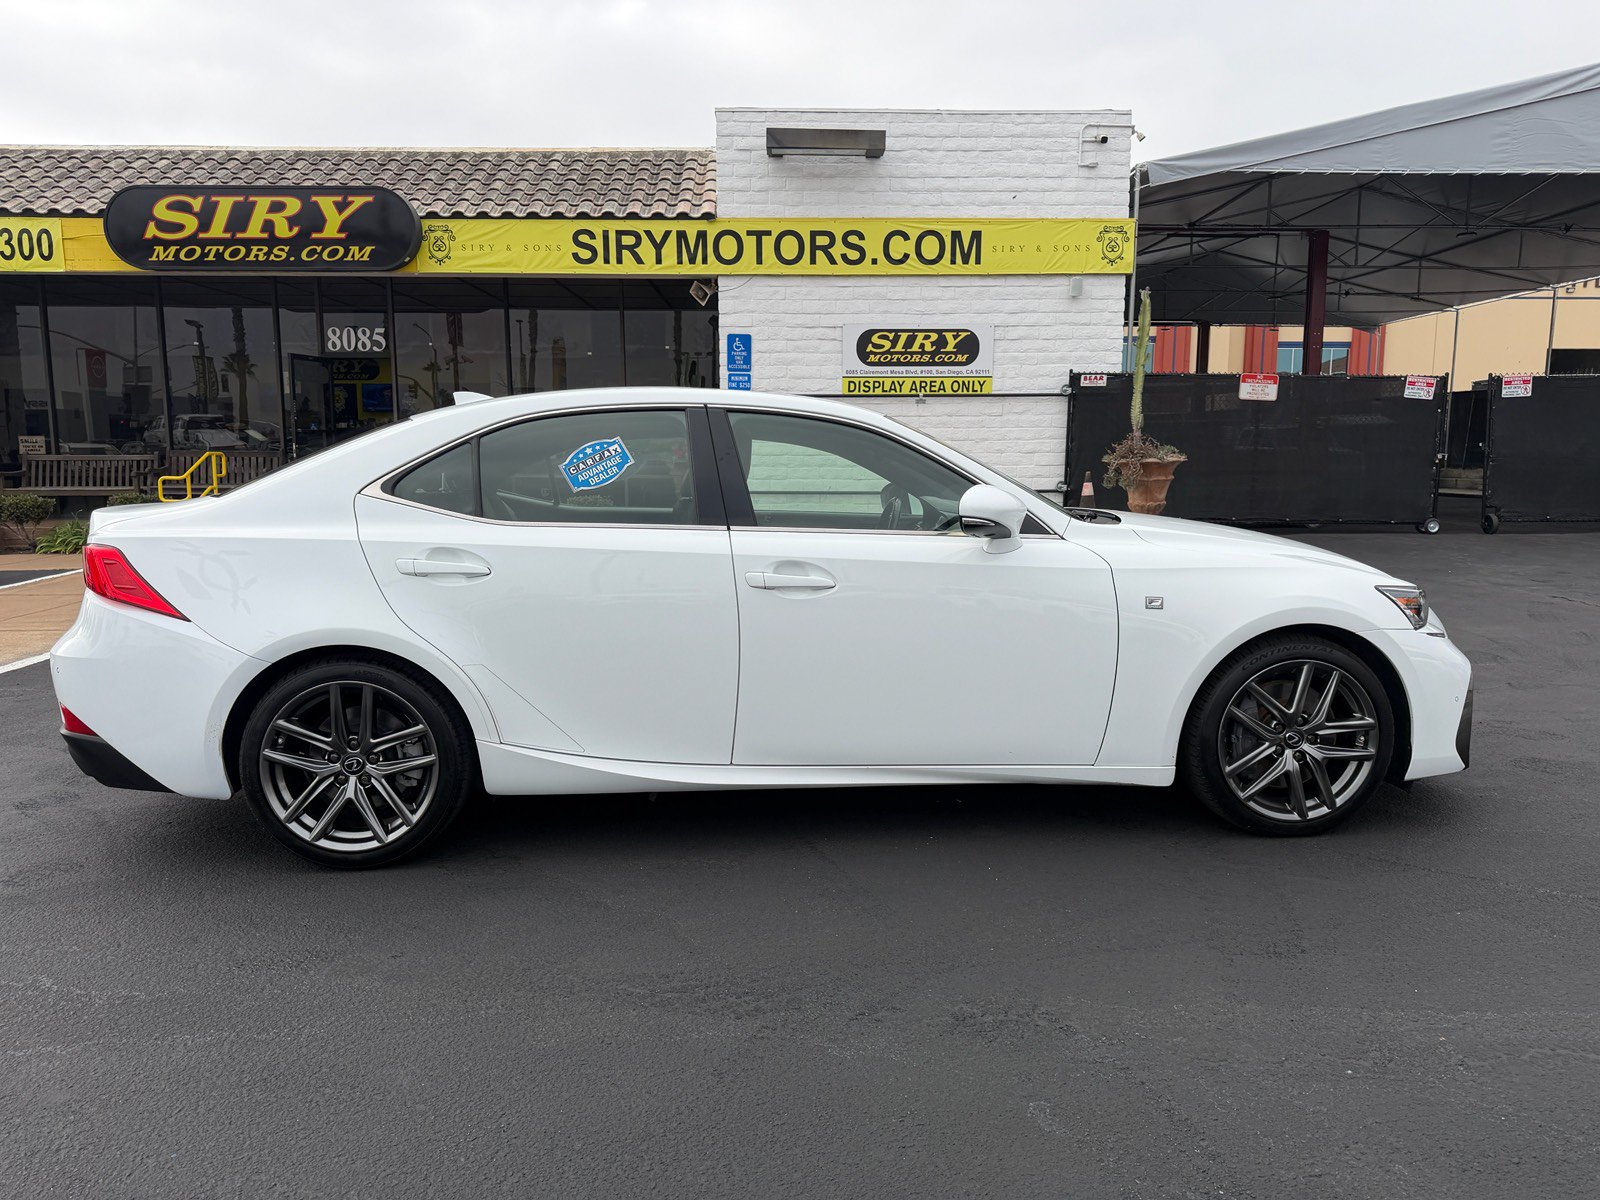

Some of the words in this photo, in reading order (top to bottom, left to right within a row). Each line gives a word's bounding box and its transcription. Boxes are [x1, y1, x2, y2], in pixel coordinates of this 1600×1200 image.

[144, 194, 375, 241] SIRY
[148, 245, 375, 262] MOTORS.COM
[461, 244, 495, 252] SIRY
[505, 244, 512, 252] &
[523, 244, 562, 252] SONS
[571, 228, 982, 266] SIRYMOTORS.COM
[991, 244, 1026, 253] SIRY
[1035, 244, 1042, 253] &
[1052, 244, 1091, 253] SONS
[327, 326, 387, 352] 8085
[865, 331, 971, 353] SIRY
[866, 354, 970, 363] MOTORS.COM
[847, 380, 906, 393] DISPLAY
[908, 380, 947, 393] AREA
[950, 380, 987, 393] ONLY
[568, 445, 621, 475] CARFAX
[577, 456, 622, 482] ADVANTAGE
[588, 466, 620, 486] DEALER
[1242, 645, 1337, 671] CONTINENTAL
